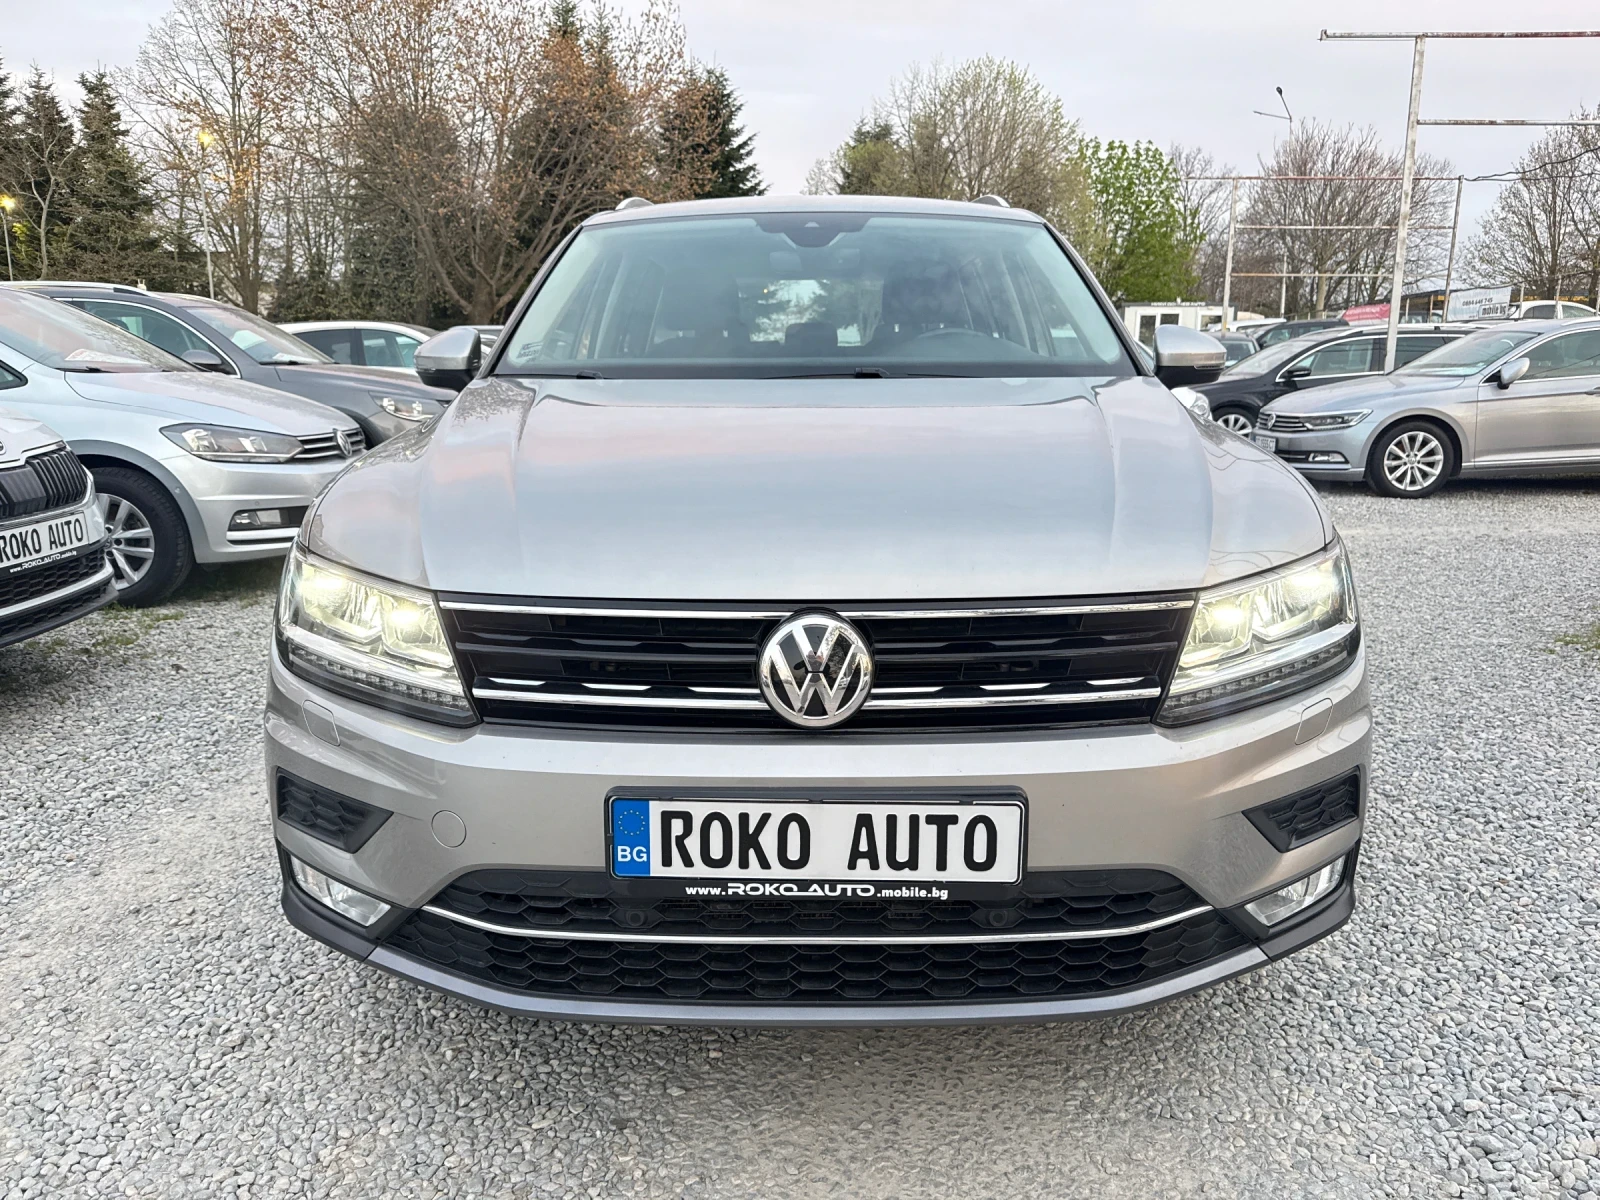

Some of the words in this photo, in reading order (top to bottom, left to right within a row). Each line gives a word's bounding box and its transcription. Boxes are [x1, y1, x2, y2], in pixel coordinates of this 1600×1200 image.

[0, 528, 42, 563] ROKO
[48, 518, 84, 550] AUTO
[617, 846, 648, 862] BG
[660, 810, 811, 871] ROKO
[847, 813, 998, 872] AUTO
